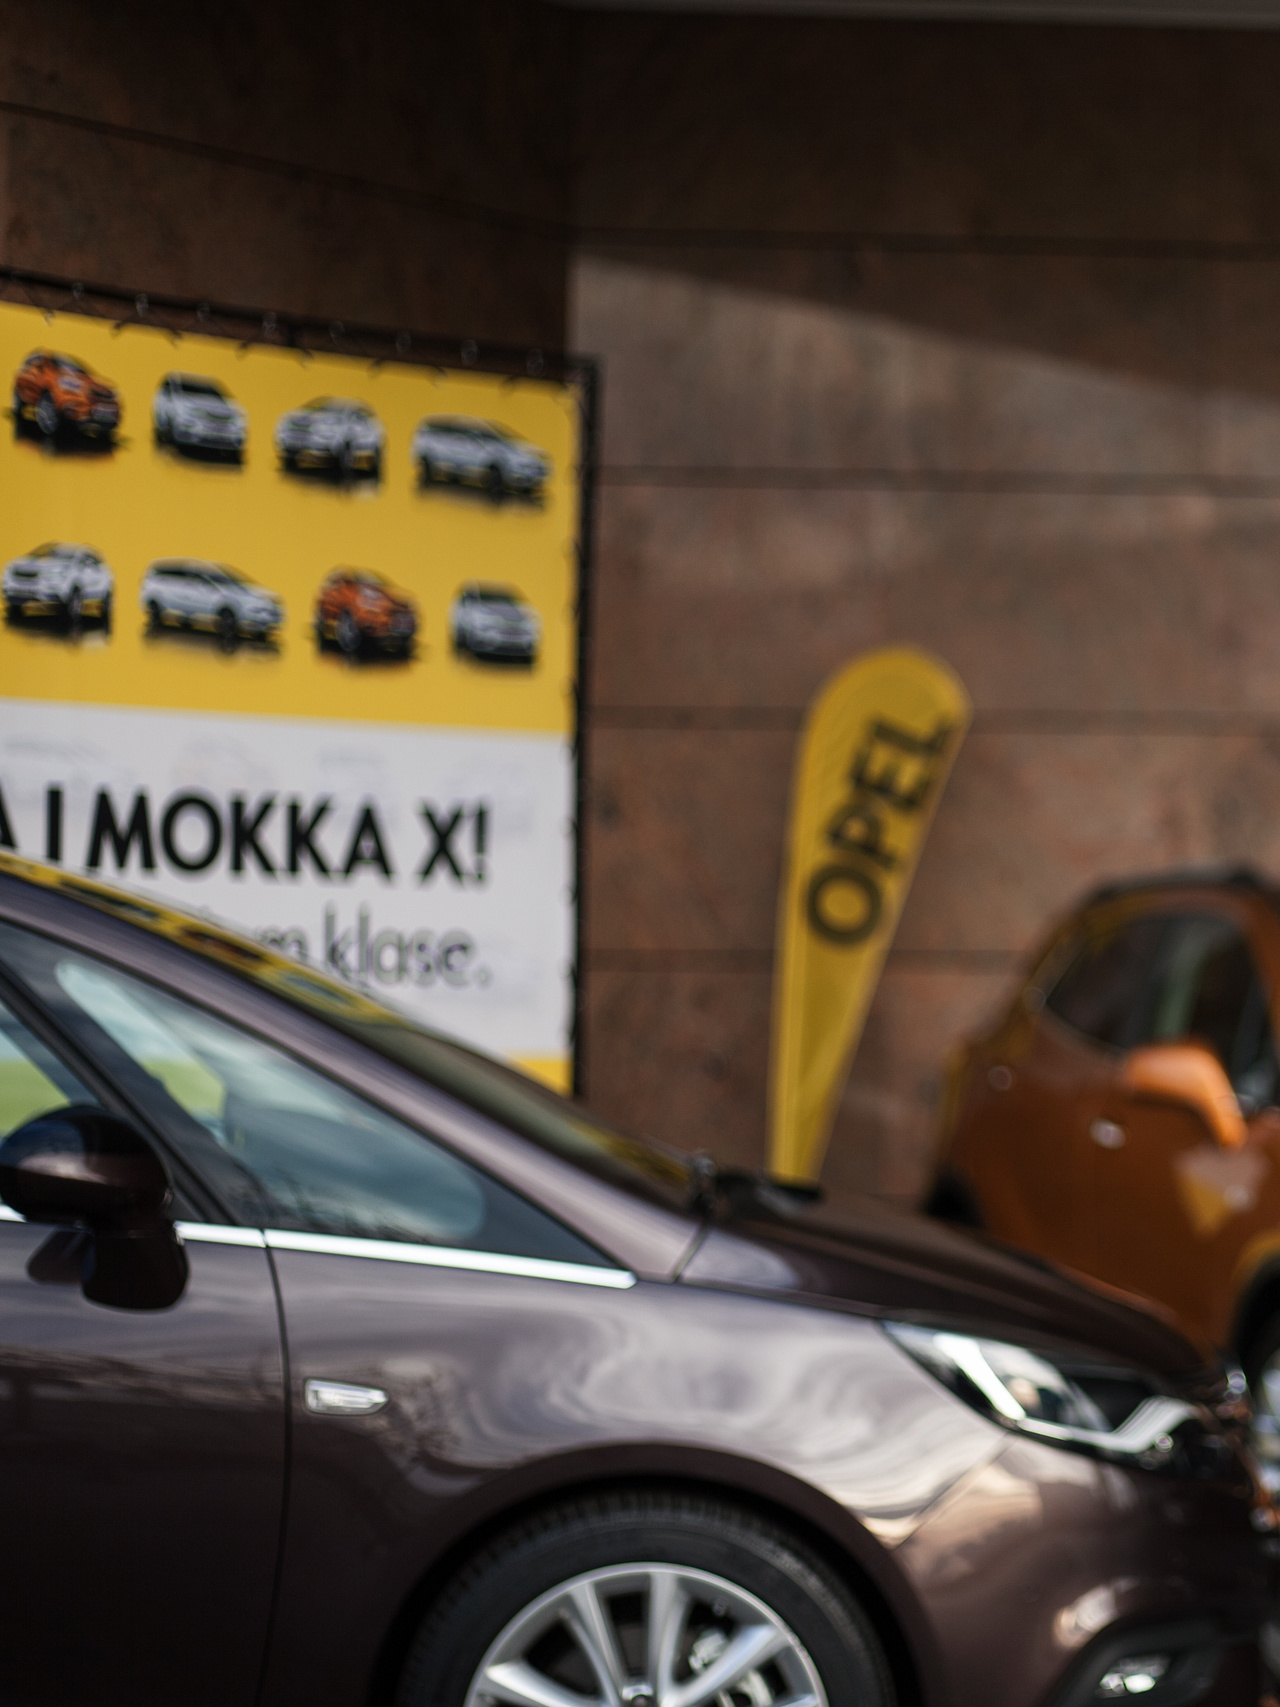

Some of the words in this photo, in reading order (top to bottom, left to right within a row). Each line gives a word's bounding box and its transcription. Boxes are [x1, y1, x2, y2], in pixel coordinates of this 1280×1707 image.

[45, 784, 64, 861] I
[87, 786, 395, 882] MOKKA
[417, 799, 489, 887] X!
[806, 716, 953, 946] OPEL
[323, 901, 492, 988] klase.
